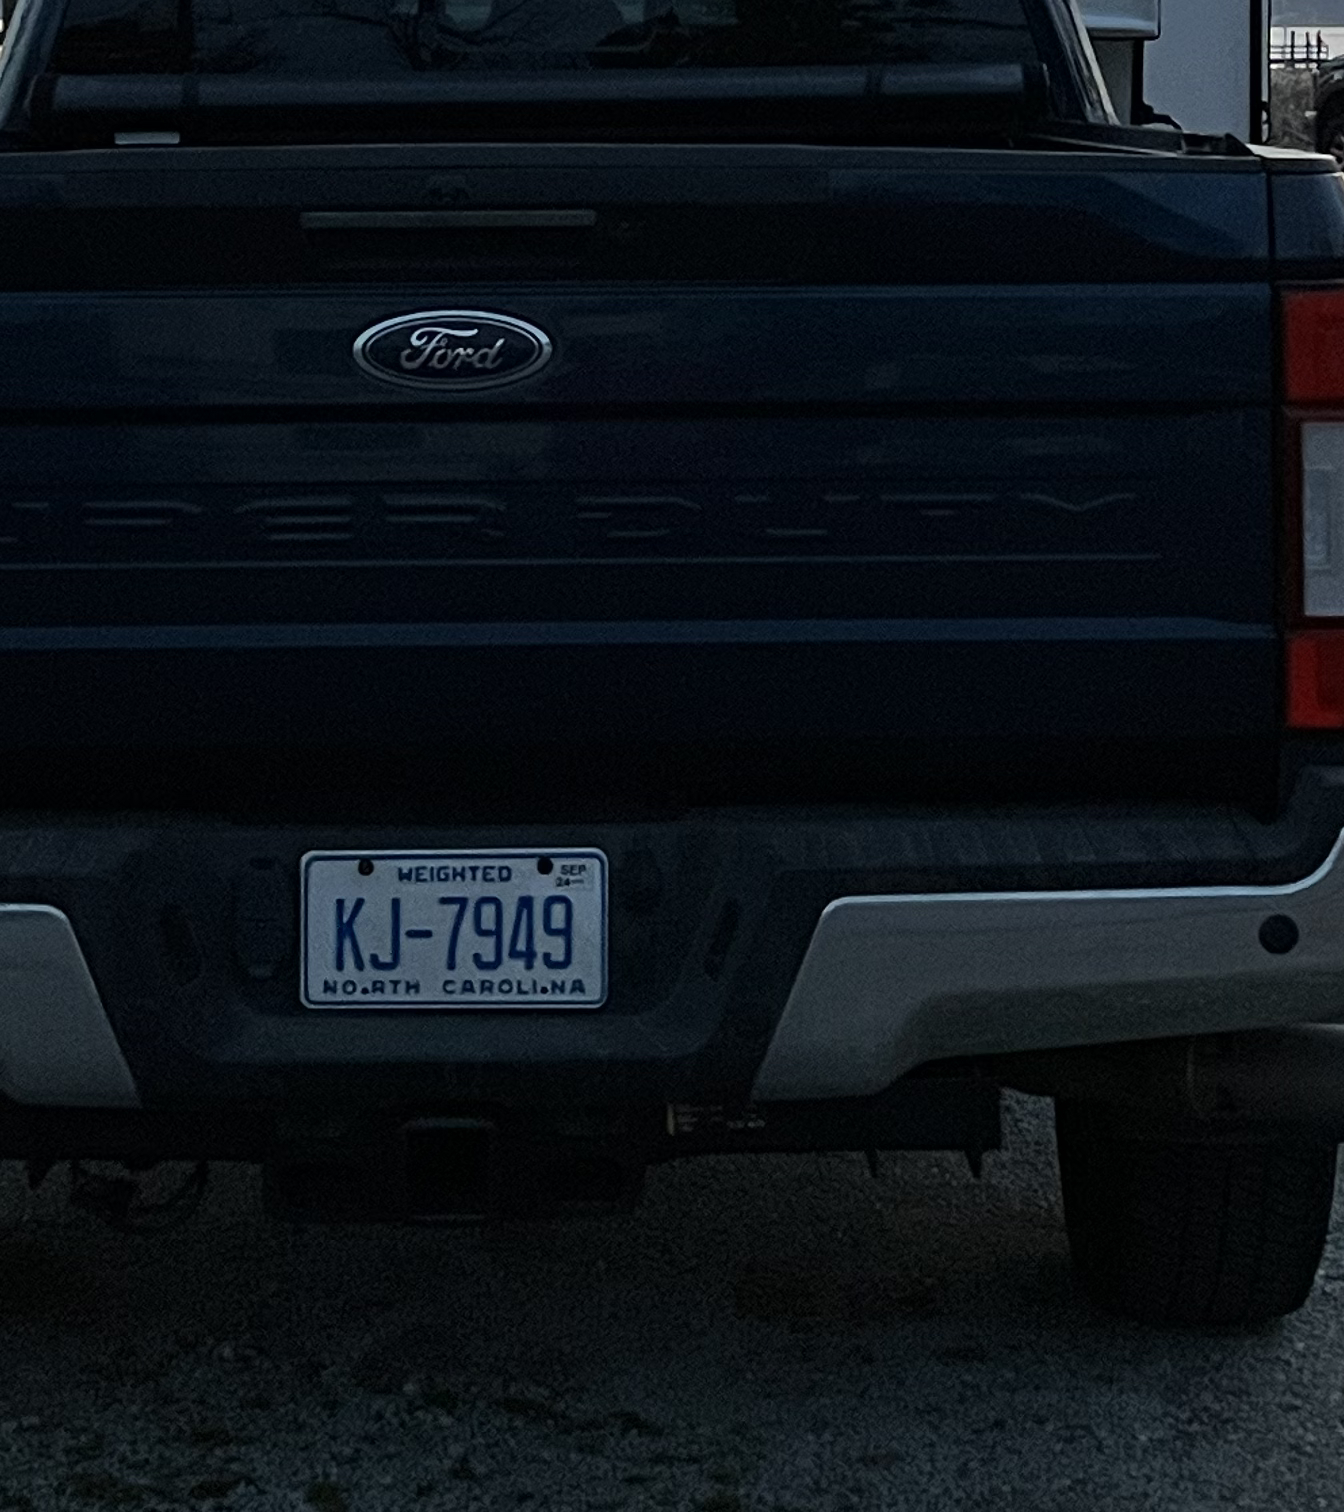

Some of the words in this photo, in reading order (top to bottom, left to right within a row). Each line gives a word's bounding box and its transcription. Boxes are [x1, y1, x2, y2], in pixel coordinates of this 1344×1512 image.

[399, 326, 506, 370] Ford
[397, 865, 513, 883] WEIGHTED
[560, 864, 587, 876] SEP
[335, 894, 574, 972] KJ-7949
[323, 978, 421, 995] NORTH
[442, 978, 587, 995] CAROLINA
